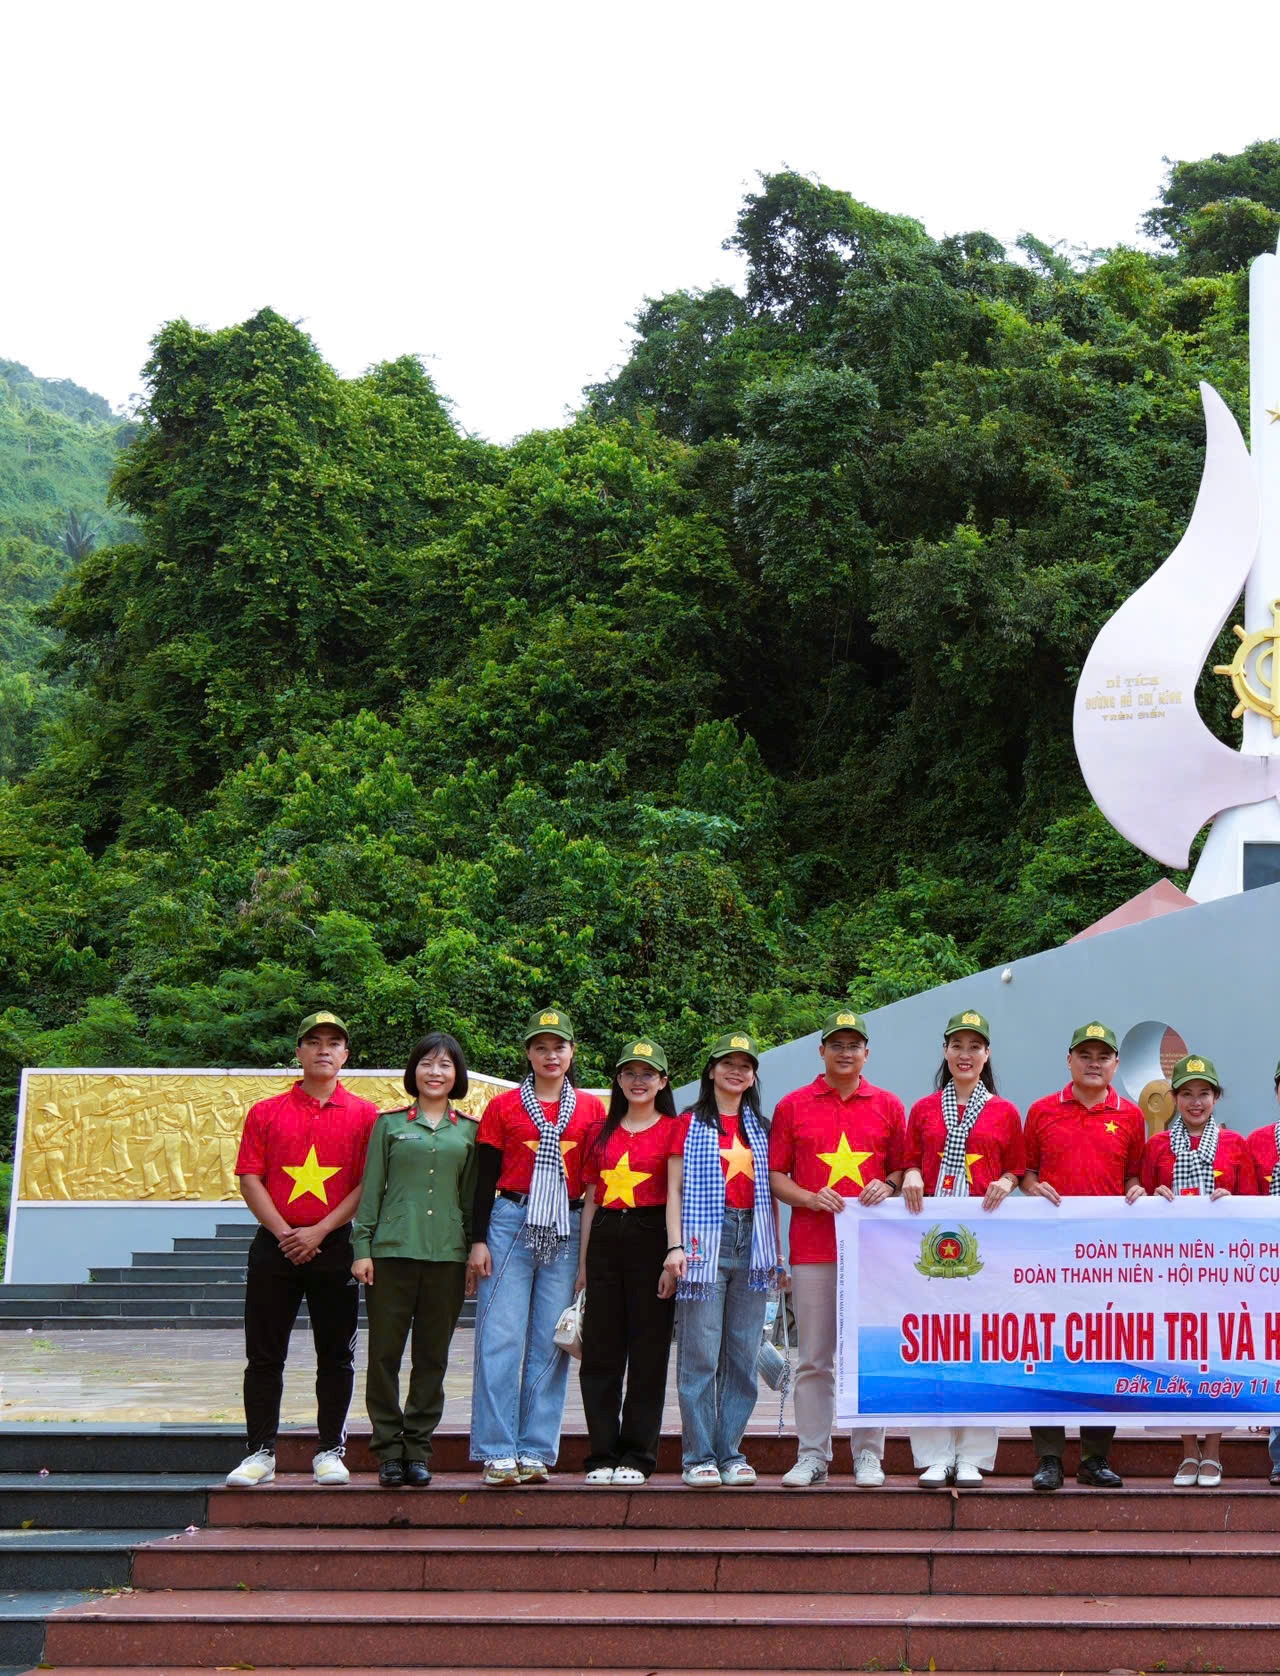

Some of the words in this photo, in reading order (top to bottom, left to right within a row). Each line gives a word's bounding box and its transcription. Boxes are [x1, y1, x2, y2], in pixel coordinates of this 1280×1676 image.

[1075, 1239, 1118, 1259] ĐOÀN
[1122, 1243, 1174, 1259] THANH
[1179, 1239, 1215, 1259] NIÊN
[1229, 1239, 1254, 1262] HỘI
[1013, 1263, 1056, 1284] ĐOÀN
[1061, 1267, 1113, 1284] THANH
[1118, 1263, 1154, 1283] NIÊN
[1168, 1263, 1193, 1286] HỘI
[1198, 1267, 1229, 1286] PHỤ
[1234, 1263, 1256, 1283] NỮ
[901, 1312, 971, 1363] SINH
[981, 1312, 1057, 1373] HOẠT
[1065, 1301, 1155, 1362] CHÍNH
[1163, 1311, 1208, 1373] TRỊ
[1217, 1301, 1256, 1361] VÀ
[1116, 1376, 1150, 1394] Đắk
[1156, 1376, 1193, 1396] Lắk,
[1199, 1378, 1242, 1397] ngày
[1251, 1379, 1269, 1393] 11
